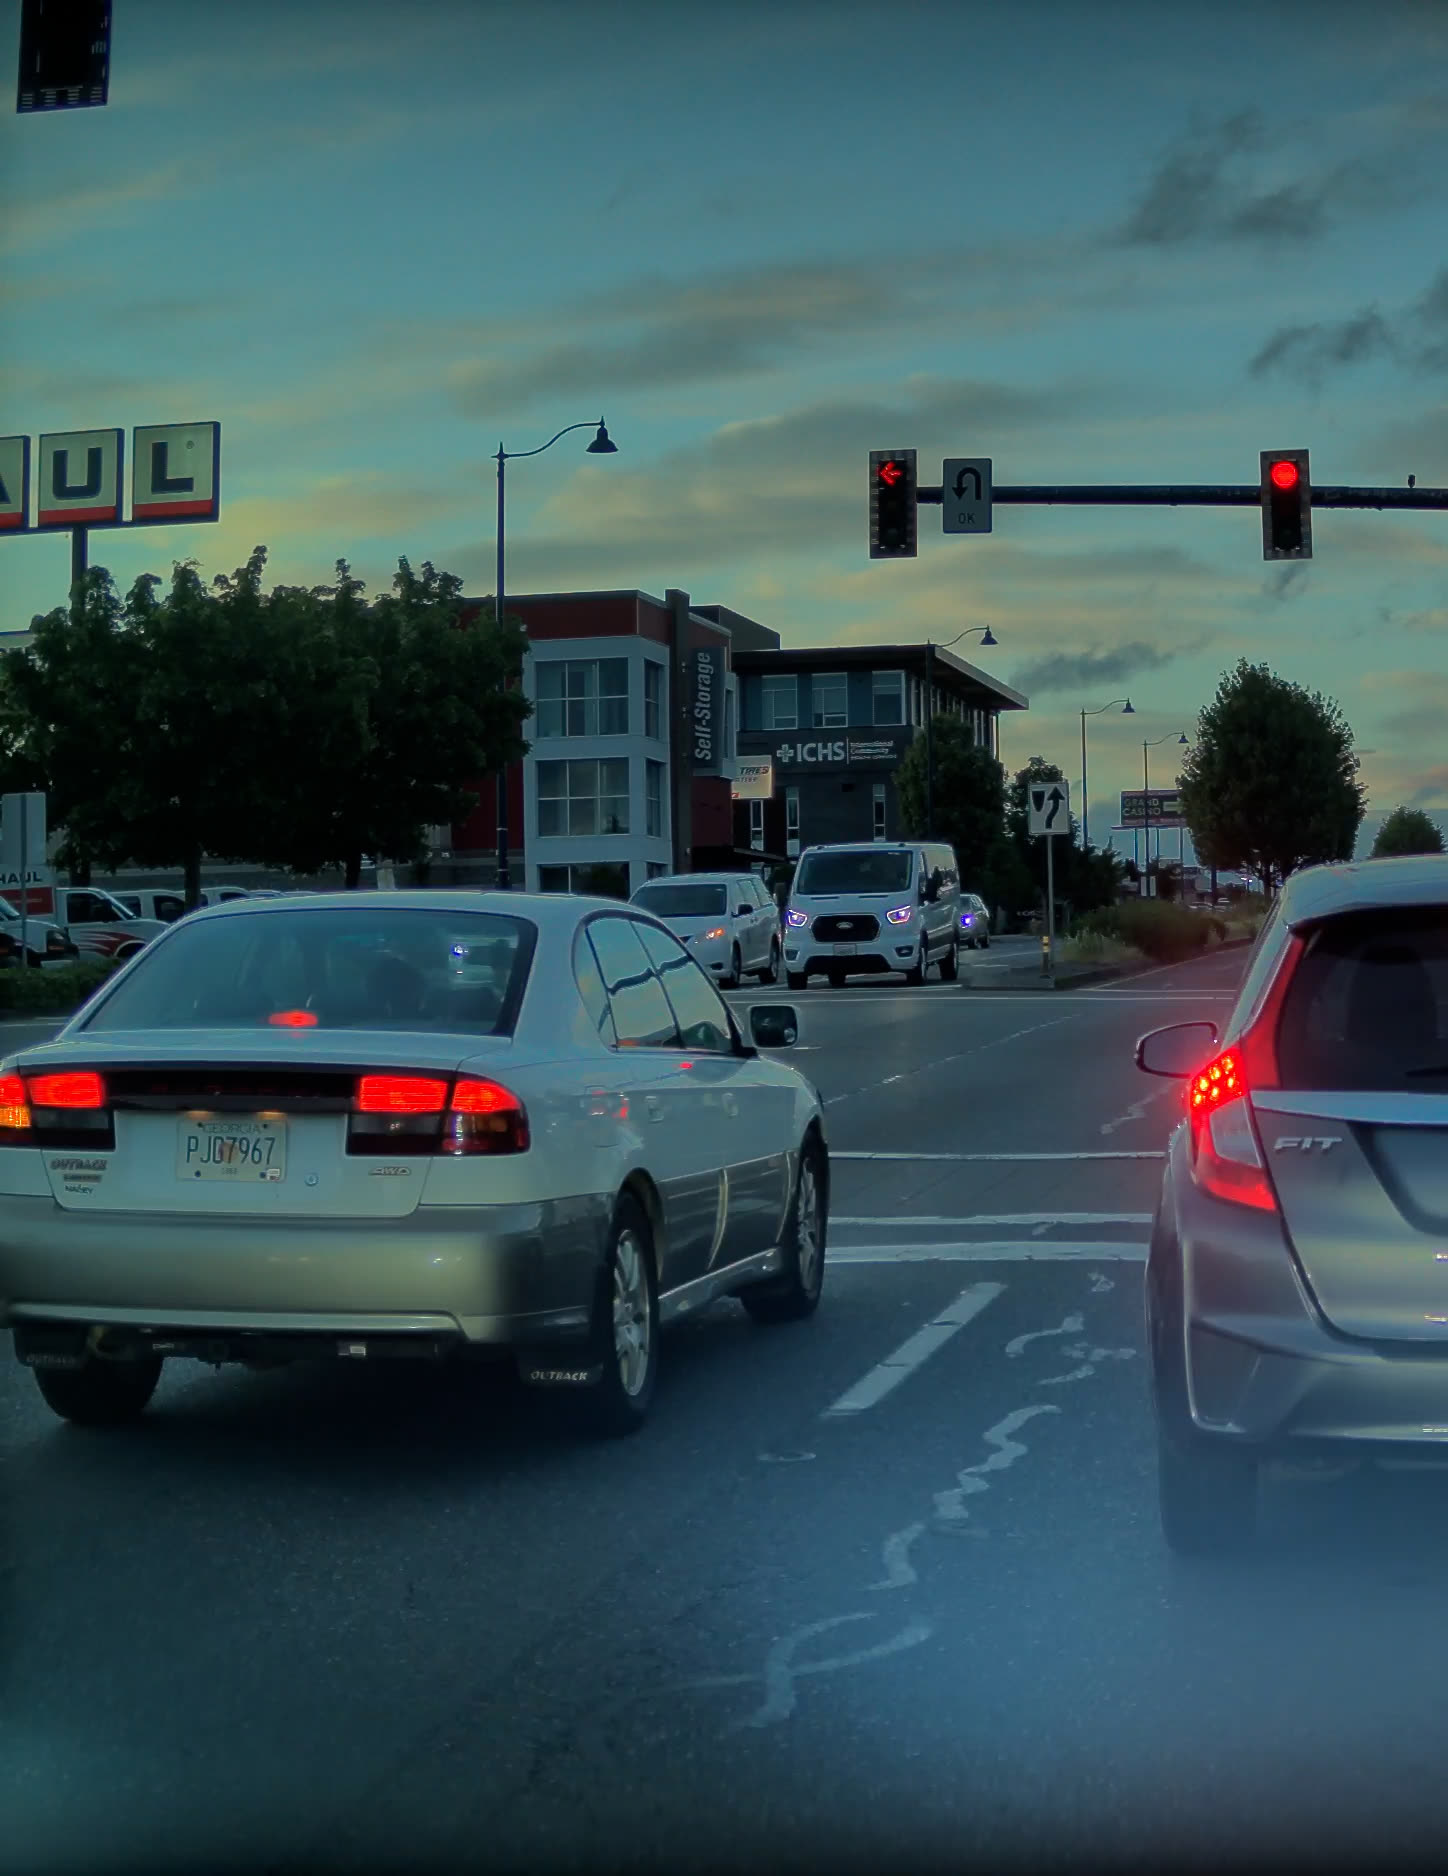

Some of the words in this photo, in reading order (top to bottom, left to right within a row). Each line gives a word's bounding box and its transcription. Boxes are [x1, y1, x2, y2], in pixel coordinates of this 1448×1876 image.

[0, 441, 194, 504] UL
[958, 512, 976, 524] OK
[694, 652, 715, 761] Self-Storage
[797, 741, 845, 761] ICHS
[1273, 1136, 1343, 1150] FIT
[369, 1167, 410, 1176] AWD
[530, 1370, 588, 1381] OUTBACK
